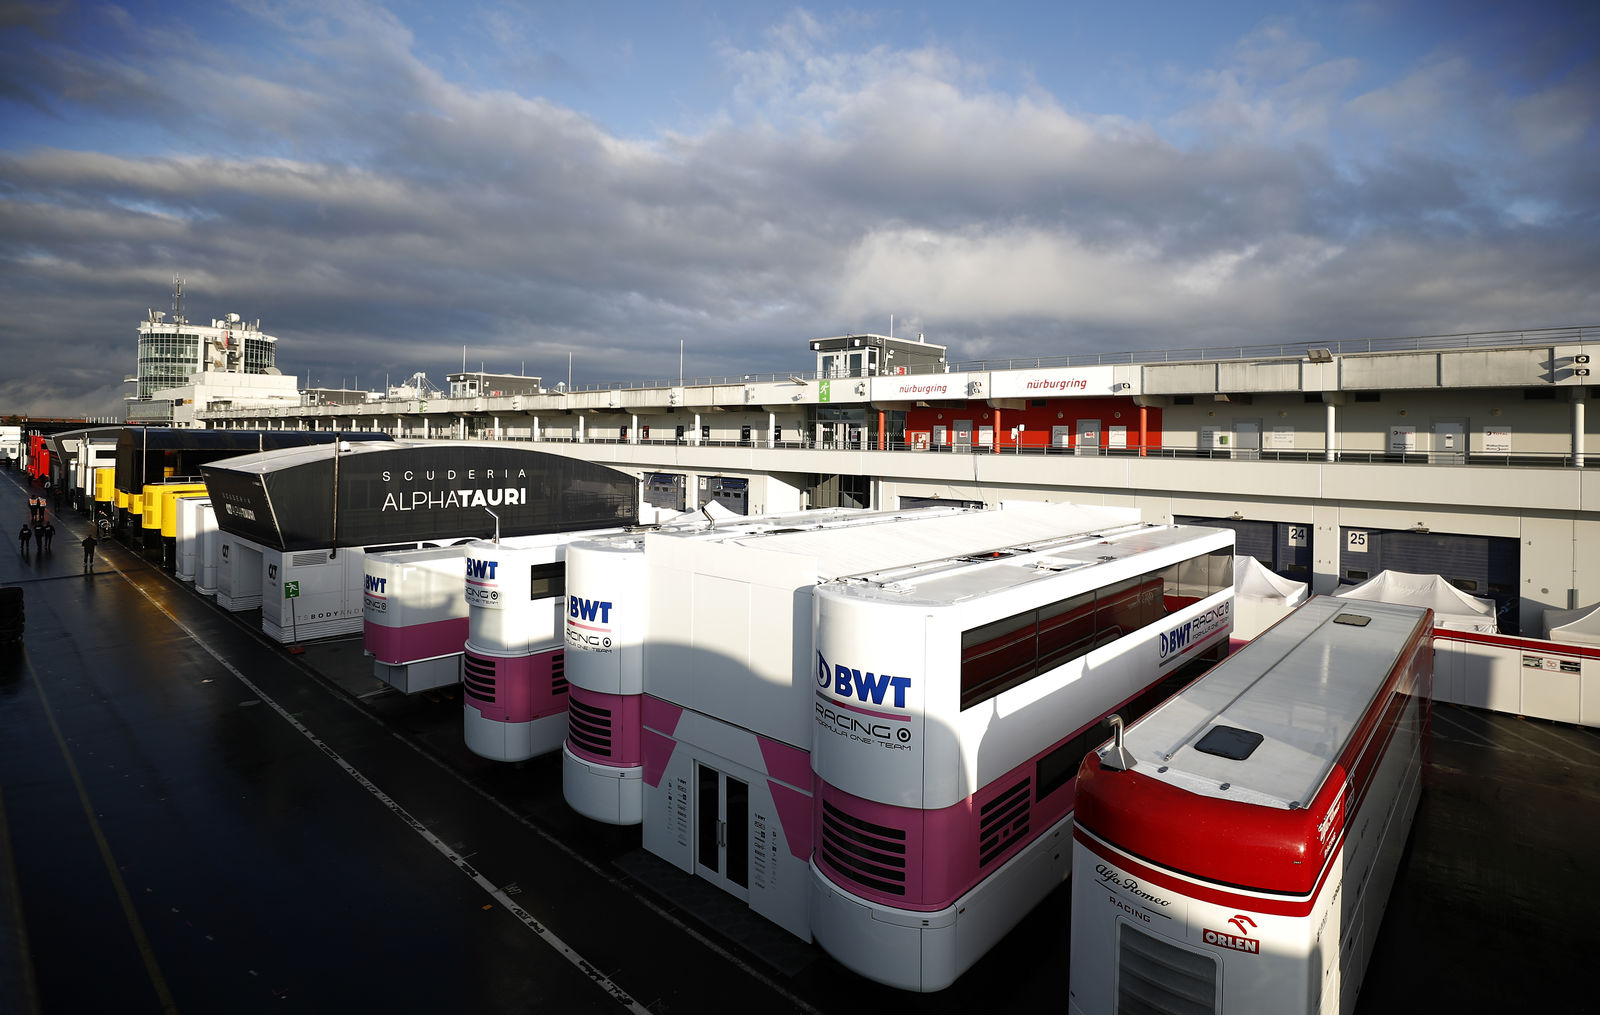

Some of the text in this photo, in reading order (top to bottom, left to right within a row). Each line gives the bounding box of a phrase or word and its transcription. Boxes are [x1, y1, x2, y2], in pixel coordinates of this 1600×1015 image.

[899, 383, 948, 395] nürburgring
[1026, 378, 1088, 391] nürburgring
[382, 469, 527, 482] SCUDERIA
[381, 487, 527, 512] ALPHATAURI
[1290, 528, 1305, 540] 24
[1350, 532, 1366, 546] 25
[466, 557, 499, 580] BWT
[365, 574, 387, 594] BWT
[570, 595, 612, 623] BWT
[1169, 621, 1192, 654] BWT
[835, 664, 911, 708] BWT
[815, 701, 891, 740] RACING
[877, 740, 912, 752] TEAM
[1095, 864, 1172, 908] Alfa Romeo
[1109, 895, 1152, 924] RACING
[1205, 931, 1257, 953] ORLEN
